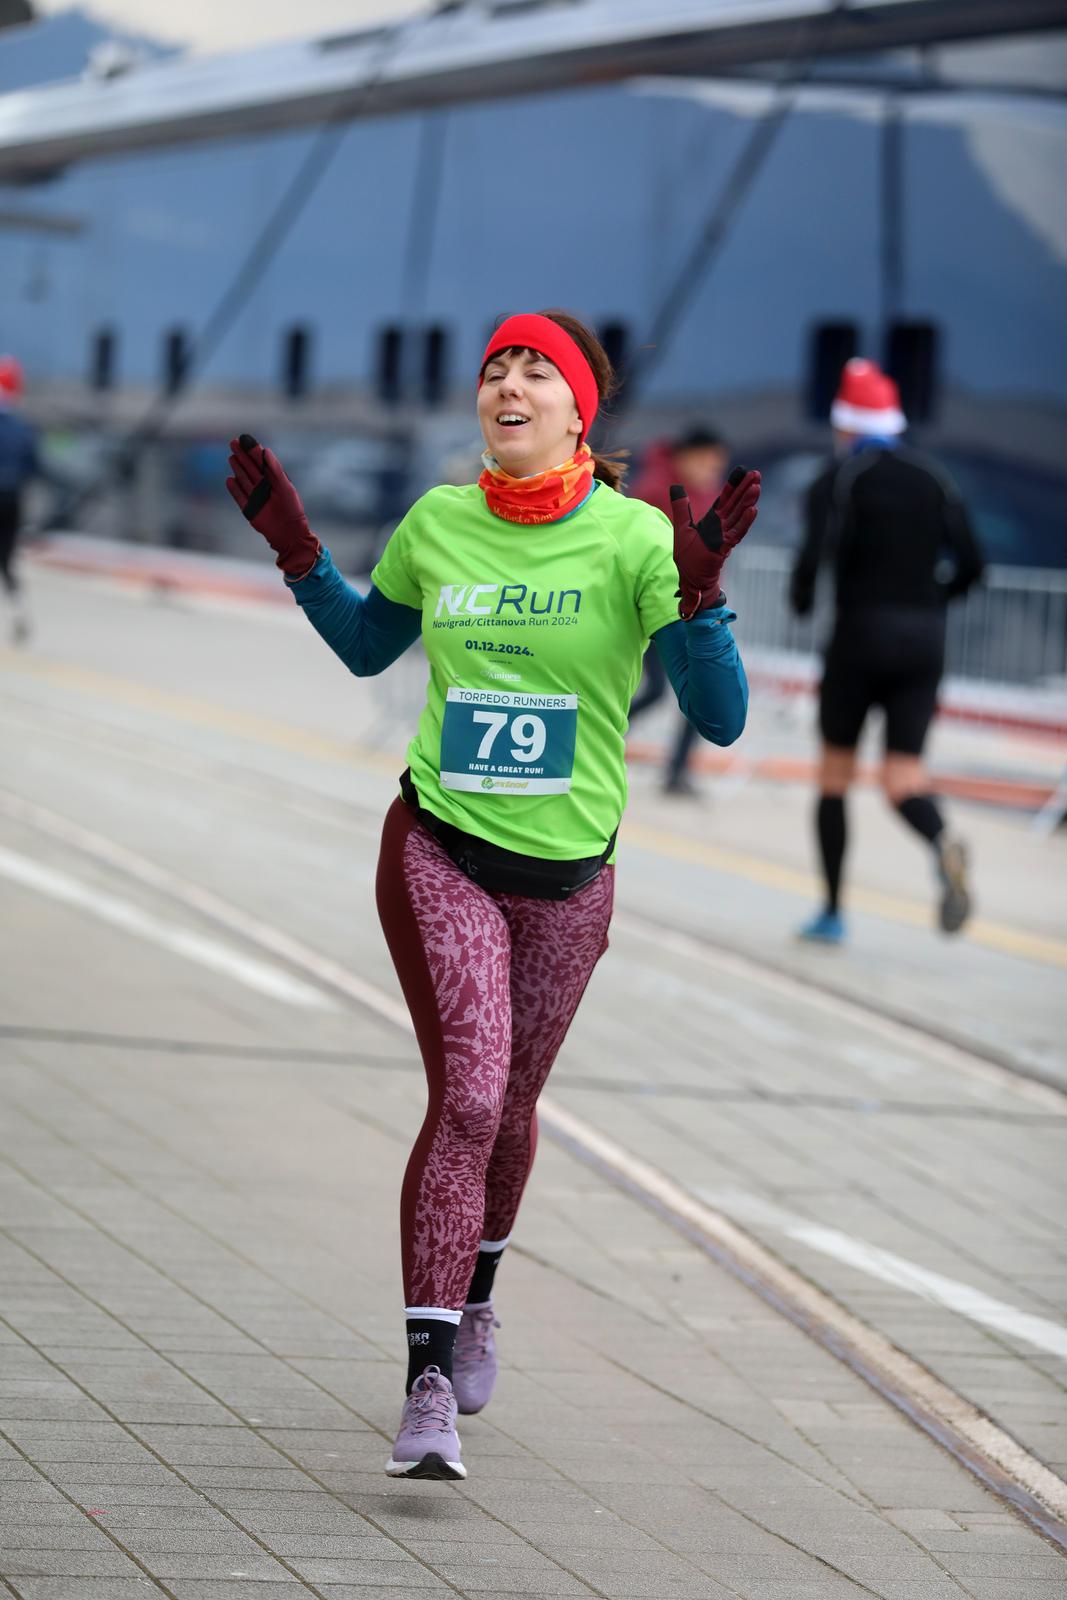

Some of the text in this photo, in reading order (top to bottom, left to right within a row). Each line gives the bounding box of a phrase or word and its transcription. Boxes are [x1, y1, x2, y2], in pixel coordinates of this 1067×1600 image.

[528, 617, 549, 626] Run
[551, 616, 578, 626] 2024
[465, 639, 534, 657] 01.12.2024.
[459, 691, 567, 708] TORPEDO RUNNERS
[472, 710, 547, 763] 79
[468, 763, 489, 772] HAVE
[497, 765, 523, 773] GREAT
[524, 767, 544, 775] RUN!
